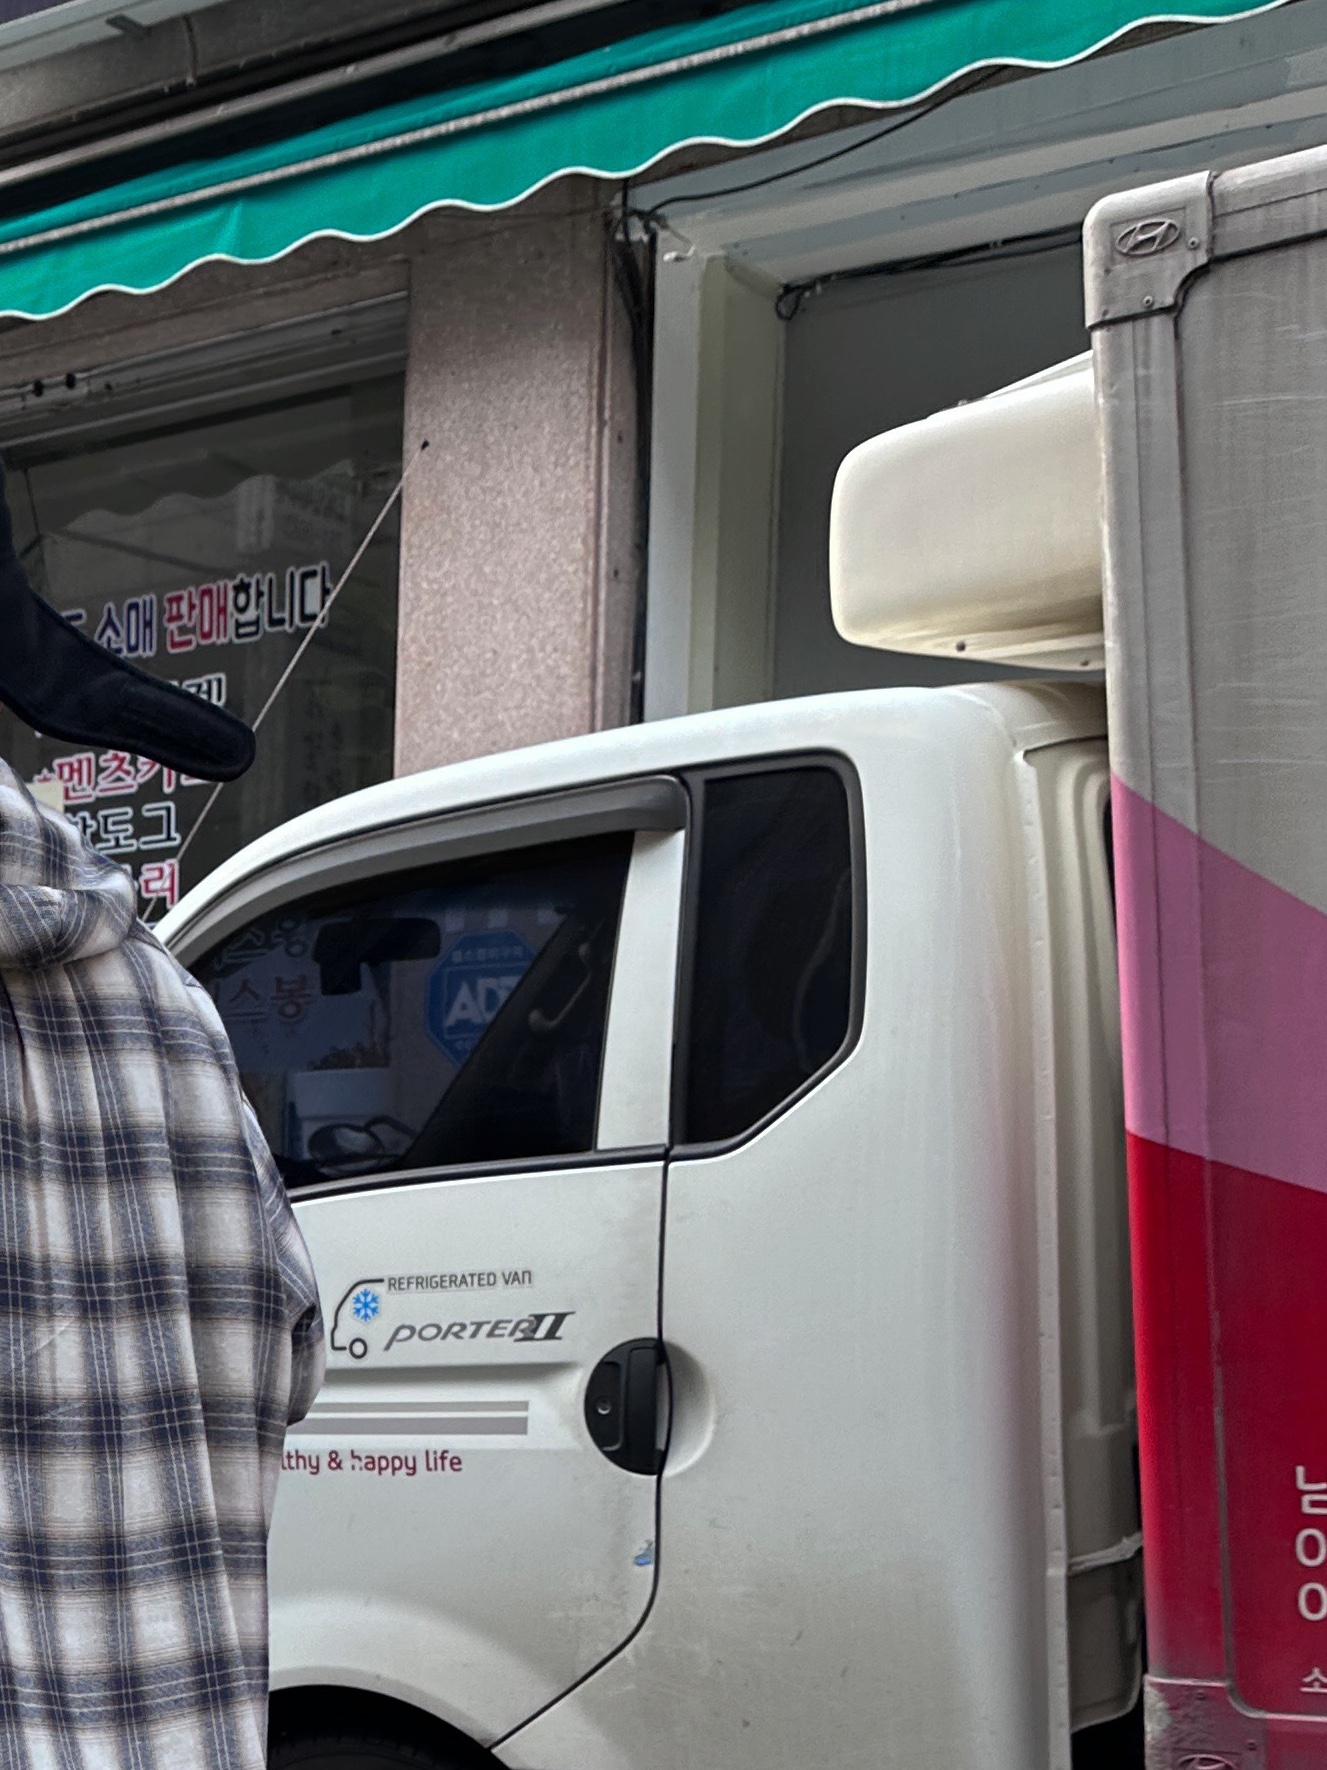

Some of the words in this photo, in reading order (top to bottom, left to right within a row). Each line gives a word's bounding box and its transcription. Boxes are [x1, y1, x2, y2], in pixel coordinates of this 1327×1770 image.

[95, 594, 156, 658] 소매
[163, 561, 333, 655] 판매합니다
[387, 1272, 497, 1291] REFRIGERATED
[351, 1450, 417, 1476] happy
[425, 1450, 463, 1472] life
